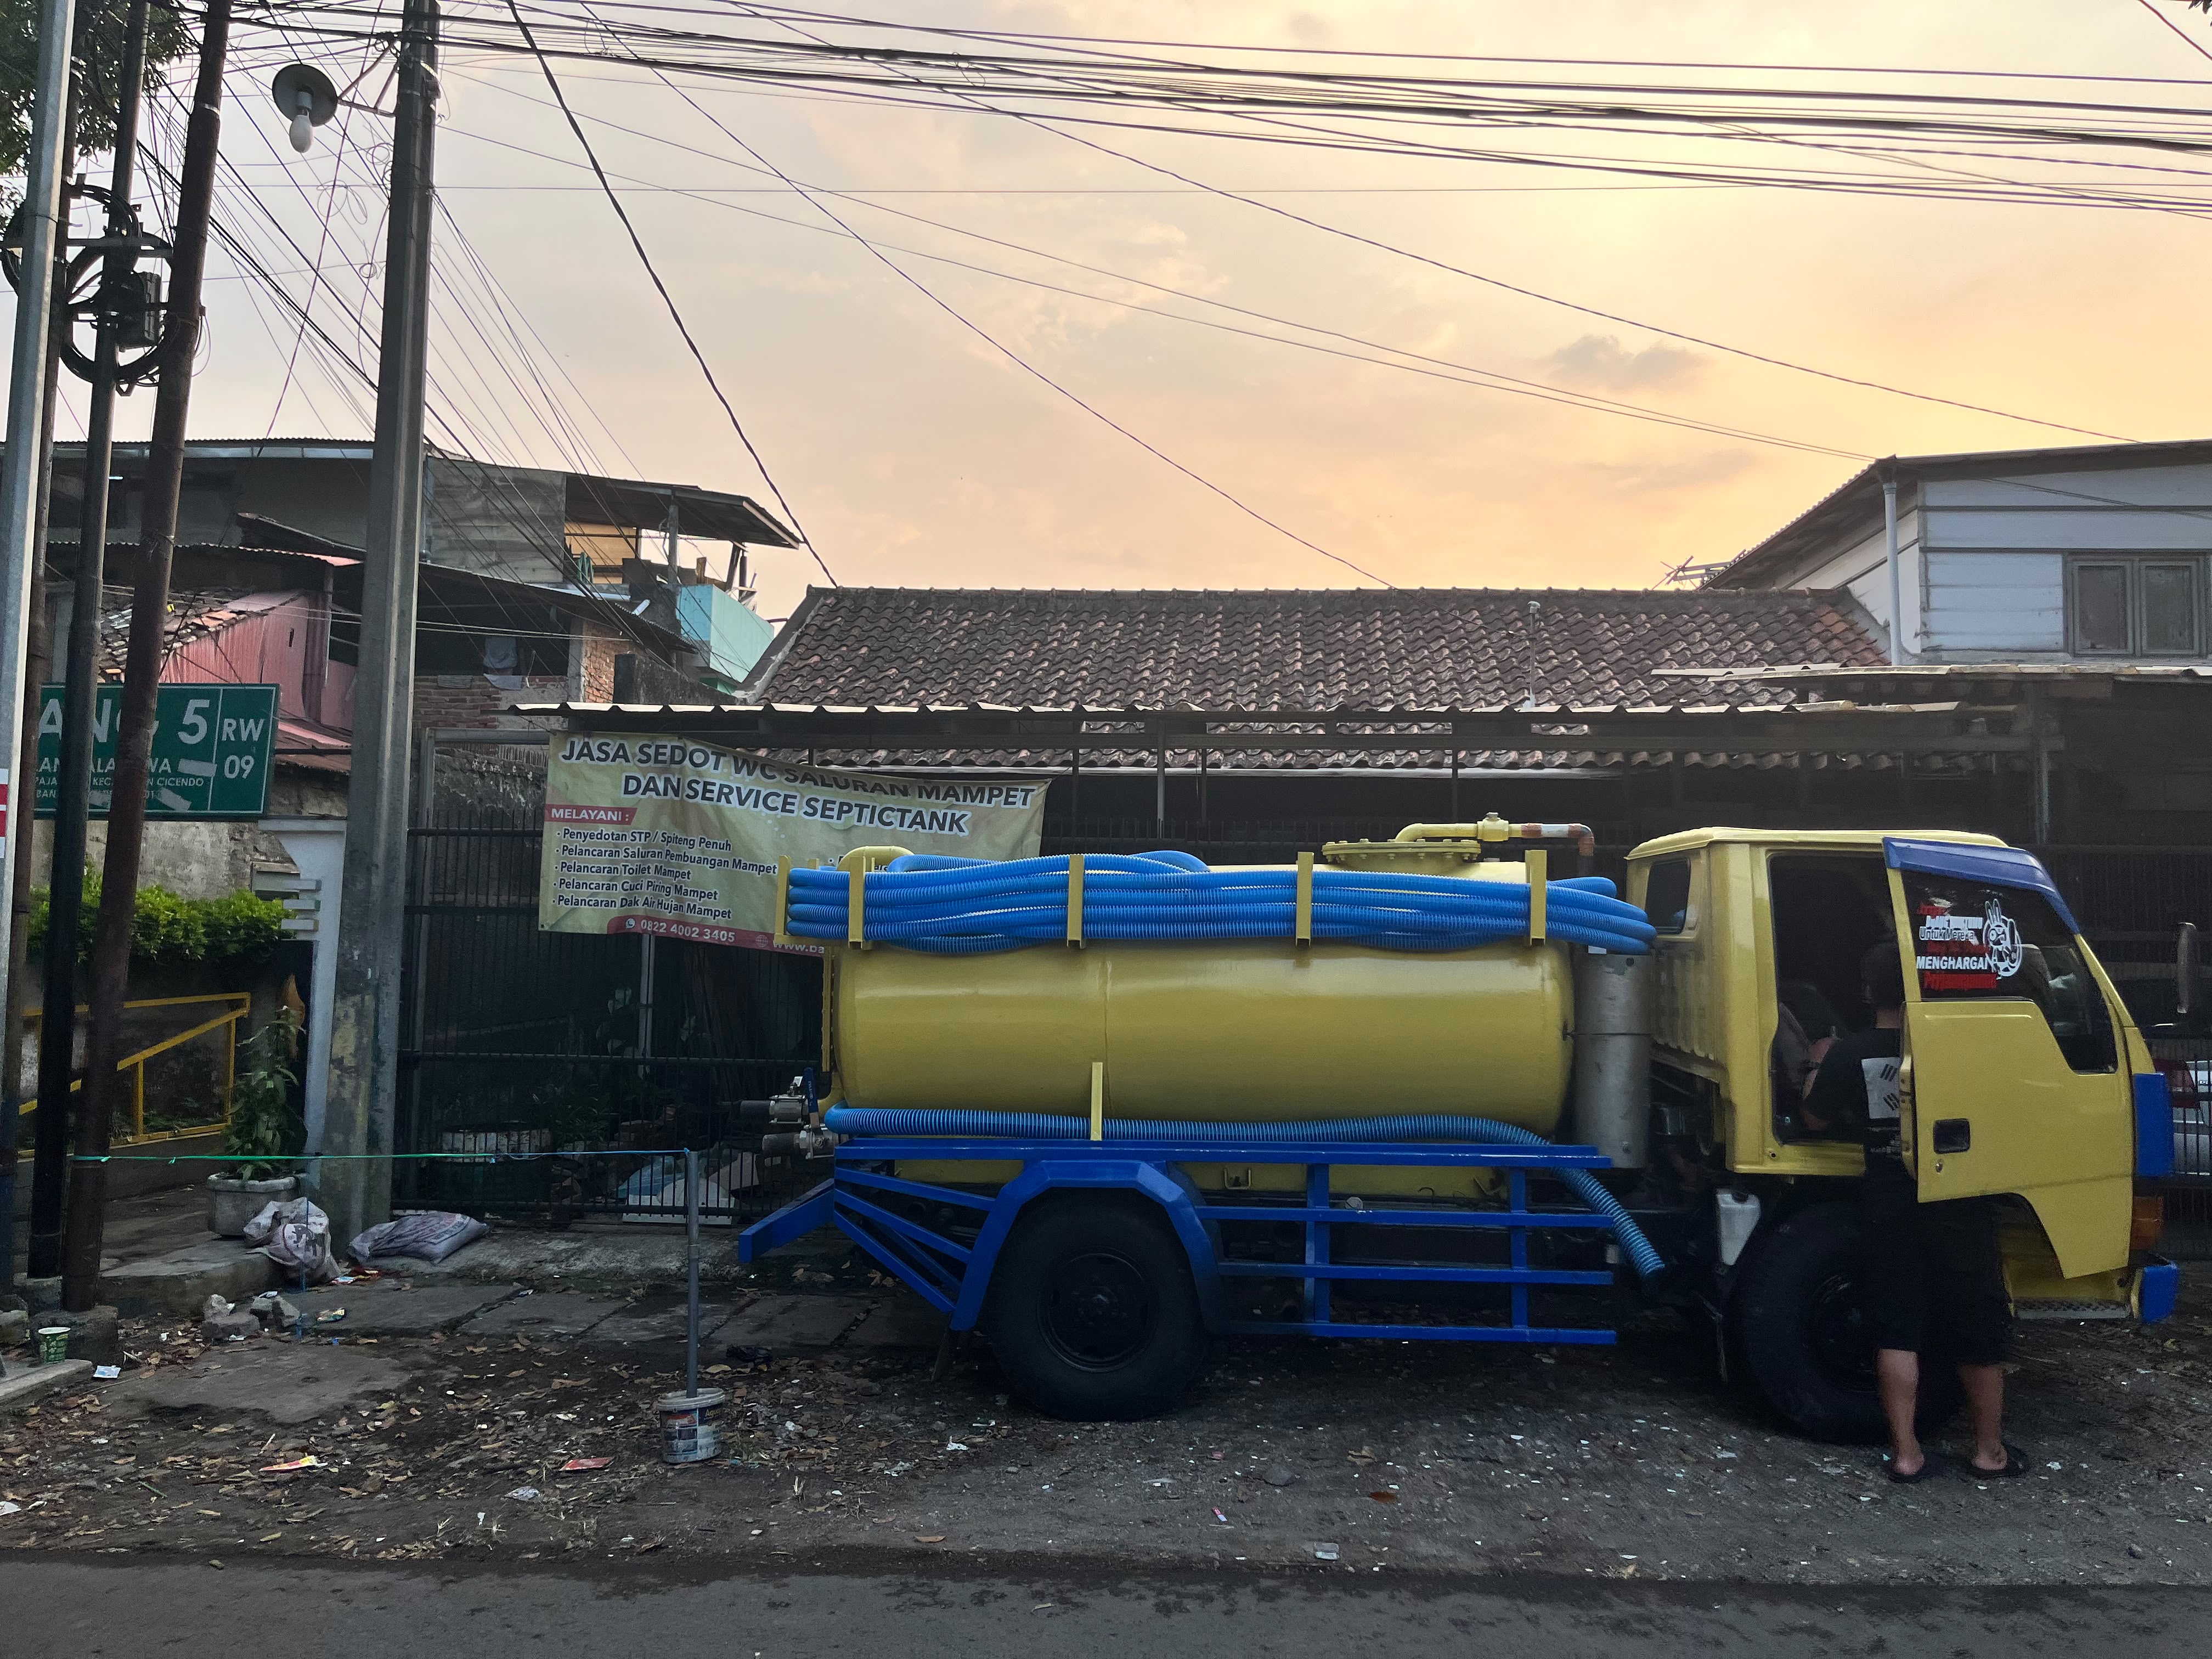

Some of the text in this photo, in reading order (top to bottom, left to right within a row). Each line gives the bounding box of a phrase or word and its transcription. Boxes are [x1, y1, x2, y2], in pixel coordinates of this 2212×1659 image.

[177, 699, 210, 744] 5
[222, 718, 265, 742] RW
[224, 754, 255, 780] 09
[561, 740, 1036, 806] JASA SEDOT WC SALURAN MAMPET
[157, 778, 204, 787] CICENDO
[551, 808, 622, 822] MELAYANI
[623, 775, 969, 833] DAN SERVICE SEPTICTANK
[563, 828, 627, 843] Penyedotan
[630, 831, 651, 842] STP
[661, 832, 695, 849] Spiteng
[698, 838, 732, 851] Penuh
[560, 862, 691, 880] Pelancaran Toilet Mampet
[561, 845, 777, 874] Pelancaran Saluran Pembuangan Mampet
[558, 879, 718, 900] Pelancaran Cuci Piring Mampet
[557, 895, 732, 919] Pelancaran Dak Air Hujan Mampet
[641, 919, 735, 942] 0822 4002 3405
